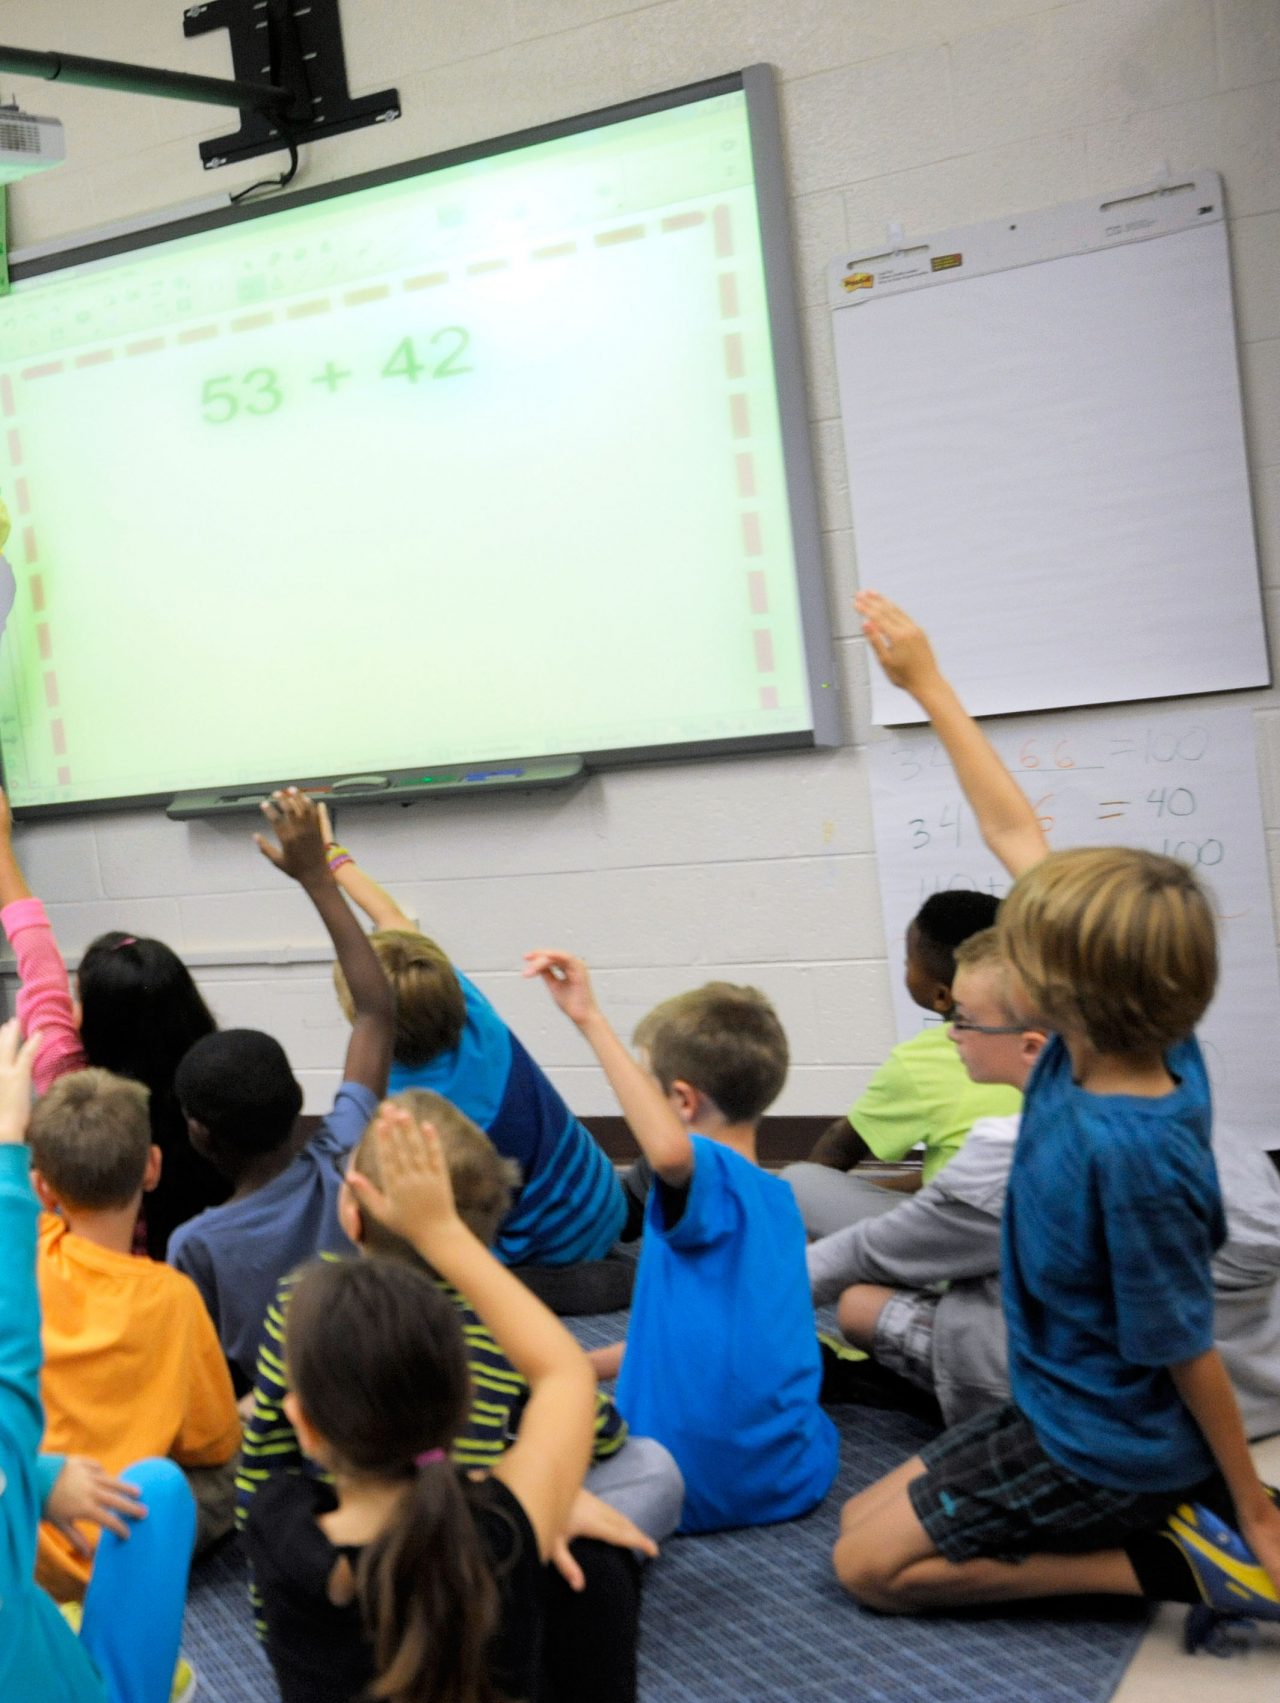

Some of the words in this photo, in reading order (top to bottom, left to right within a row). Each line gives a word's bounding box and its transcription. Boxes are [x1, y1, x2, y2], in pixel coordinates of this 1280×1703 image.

[201, 366, 283, 424] 53
[310, 361, 352, 393] +
[381, 325, 474, 384] 42
[1019, 739, 1076, 769] 66
[1145, 726, 1210, 764] 100
[908, 803, 963, 850] 34
[1146, 787, 1196, 819] 40
